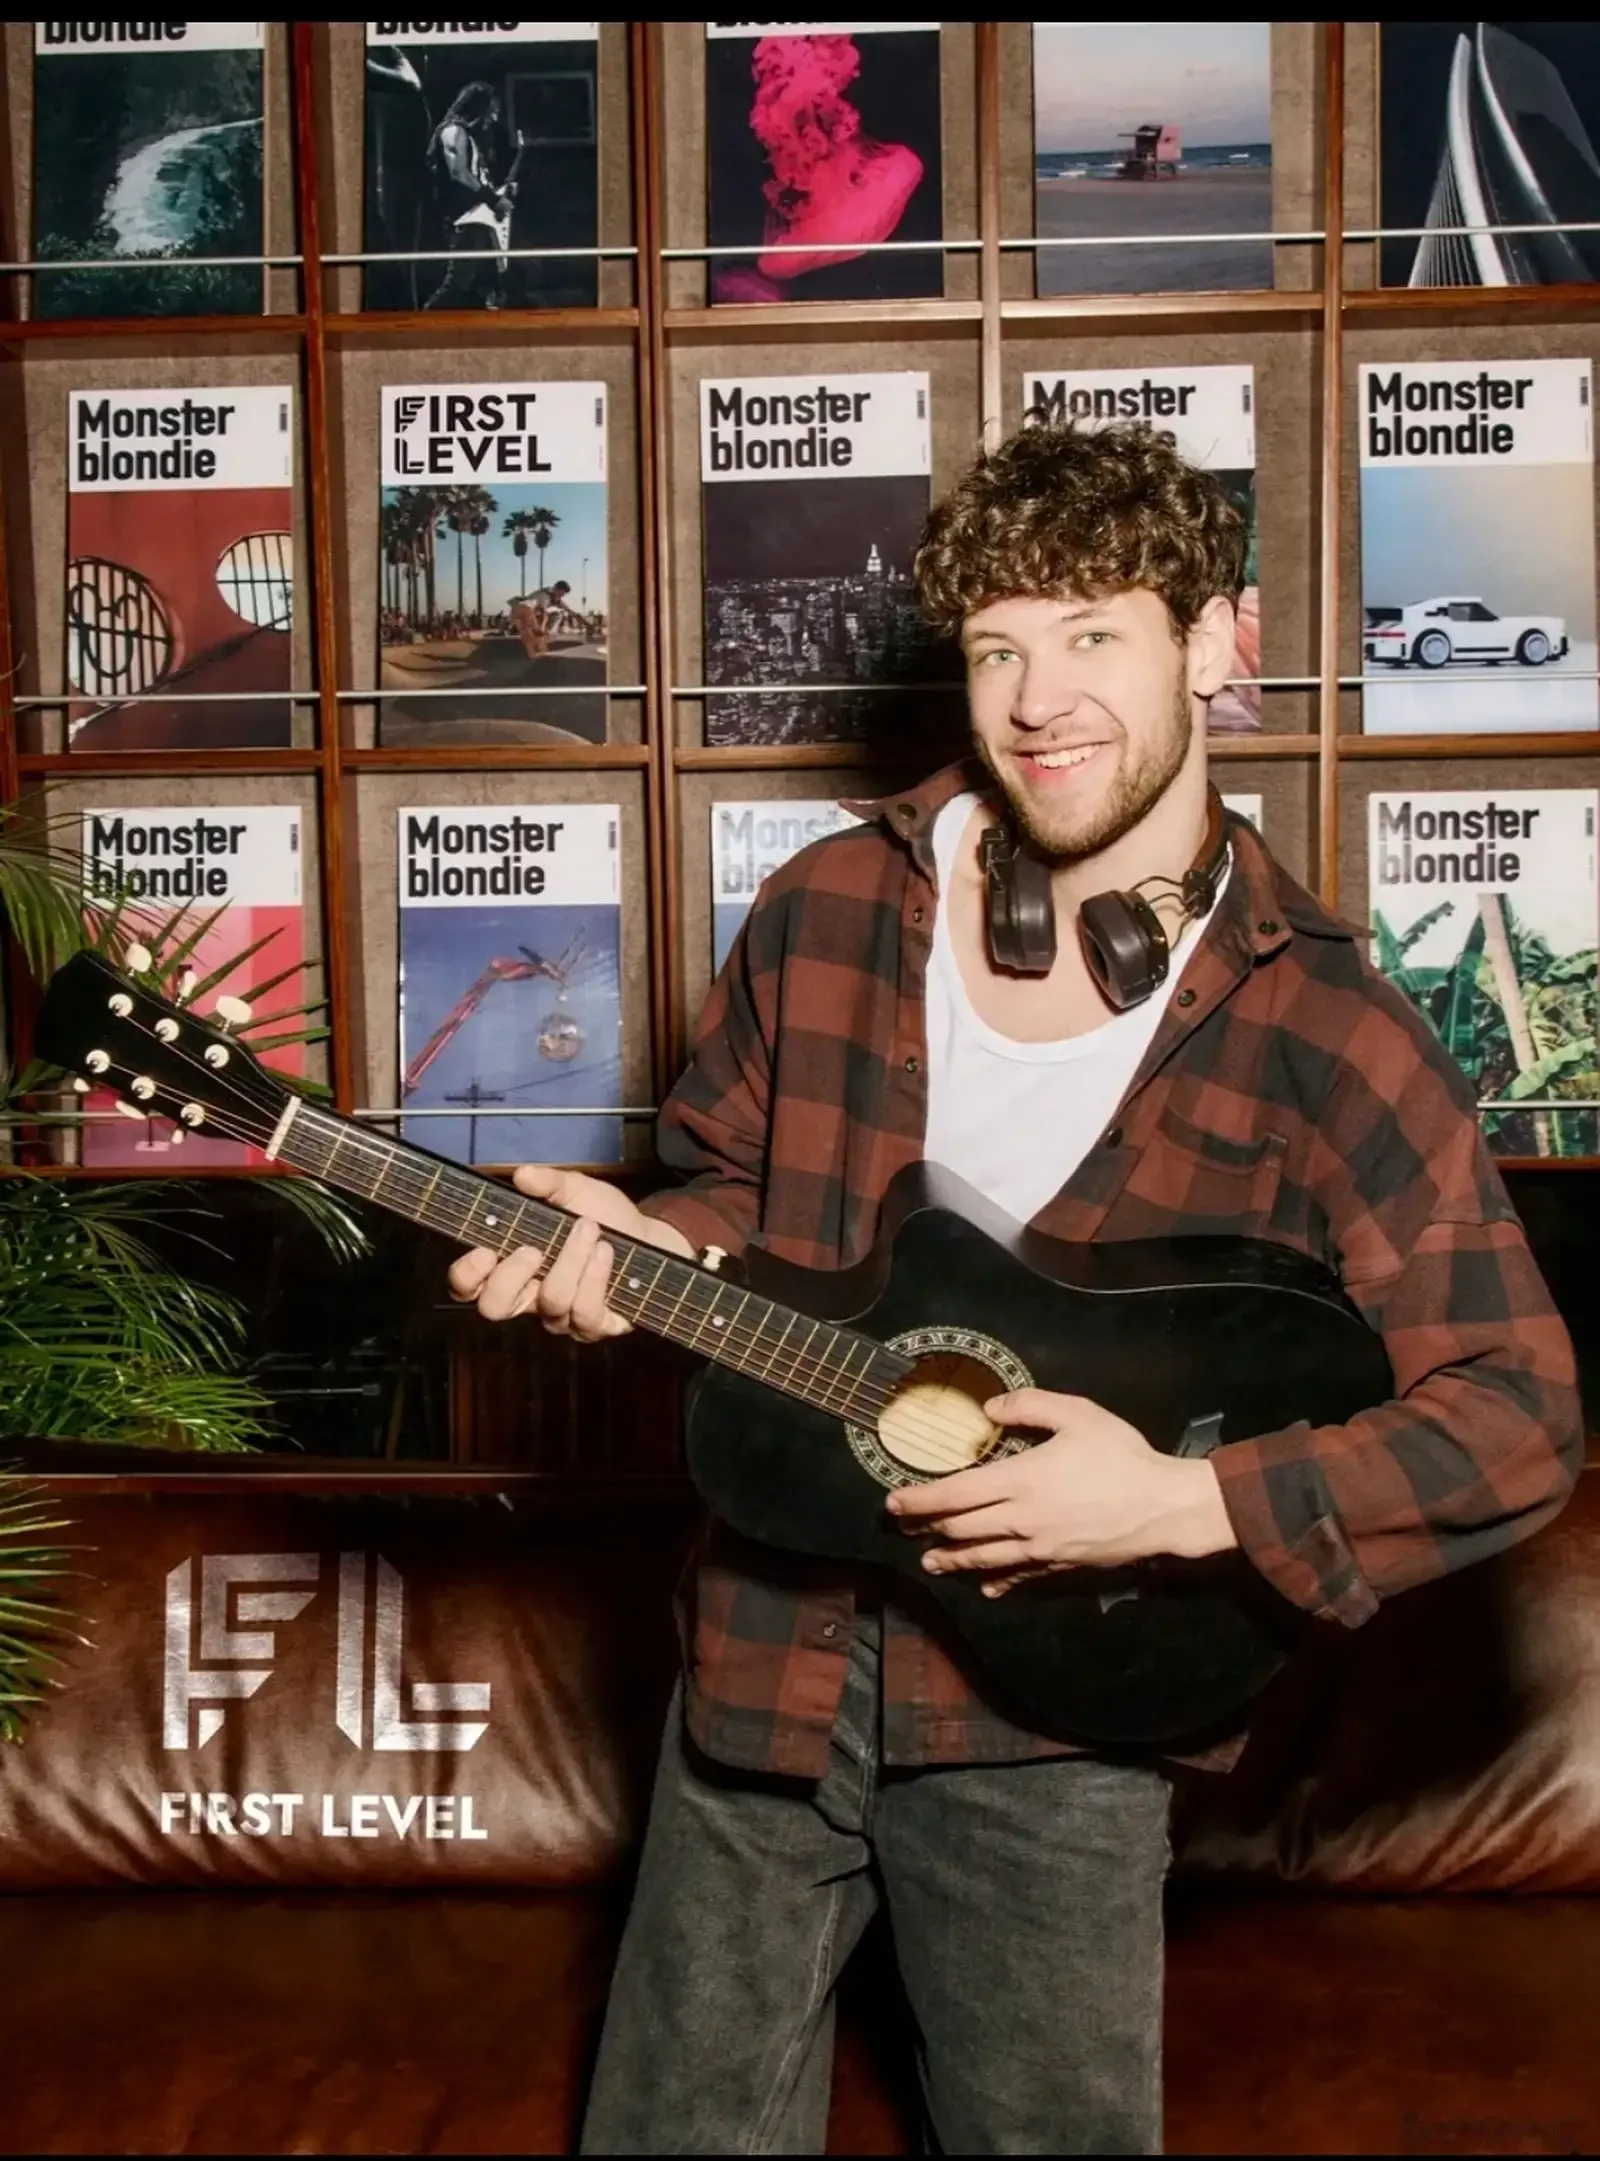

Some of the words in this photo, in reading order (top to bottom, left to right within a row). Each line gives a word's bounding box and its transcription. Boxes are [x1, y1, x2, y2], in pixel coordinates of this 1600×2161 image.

[395, 393, 536, 432] FIRST
[709, 387, 871, 429] Monster
[1032, 379, 1196, 424] Monster
[1367, 372, 1533, 413] Monster
[77, 399, 235, 438] Monster
[1368, 413, 1514, 457] blondie
[77, 440, 216, 482] blondie
[394, 435, 552, 475] LEVEL
[710, 427, 853, 472] blondie
[92, 816, 247, 856] Monster
[407, 815, 564, 855] Monster
[720, 809, 842, 852] Mons
[1377, 801, 1540, 842] Monster
[92, 857, 228, 899] blondie
[407, 856, 545, 897] blondie
[1377, 842, 1520, 885] blondie
[160, 1792, 304, 1838] FIRST
[321, 1794, 489, 1840] LEVEL
